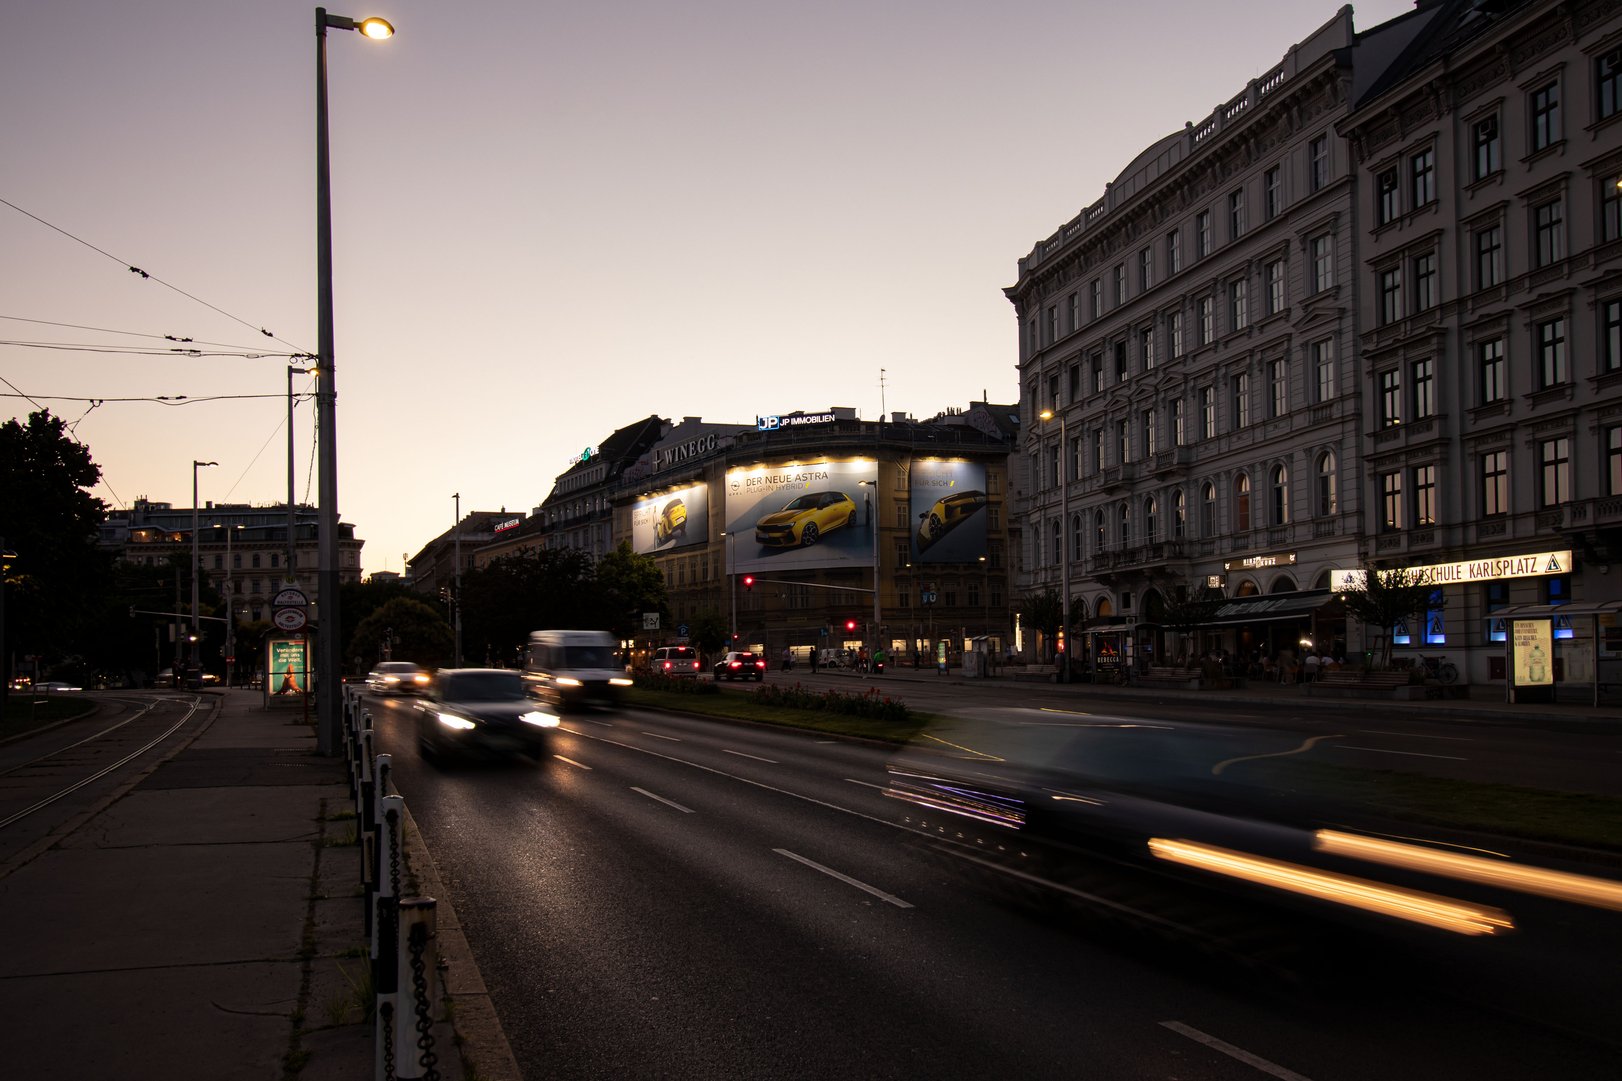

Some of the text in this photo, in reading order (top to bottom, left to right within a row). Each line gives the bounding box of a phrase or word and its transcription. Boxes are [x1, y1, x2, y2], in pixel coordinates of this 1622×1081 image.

[760, 417, 778, 429] JP
[780, 414, 835, 426] JP IMMOBILIEN
[664, 434, 716, 465] WINEGG
[746, 471, 829, 487] DER NEUE ASTRA
[746, 482, 804, 493] PLUG-IN HYBRID
[1469, 557, 1538, 579] KARLSPLATZ
